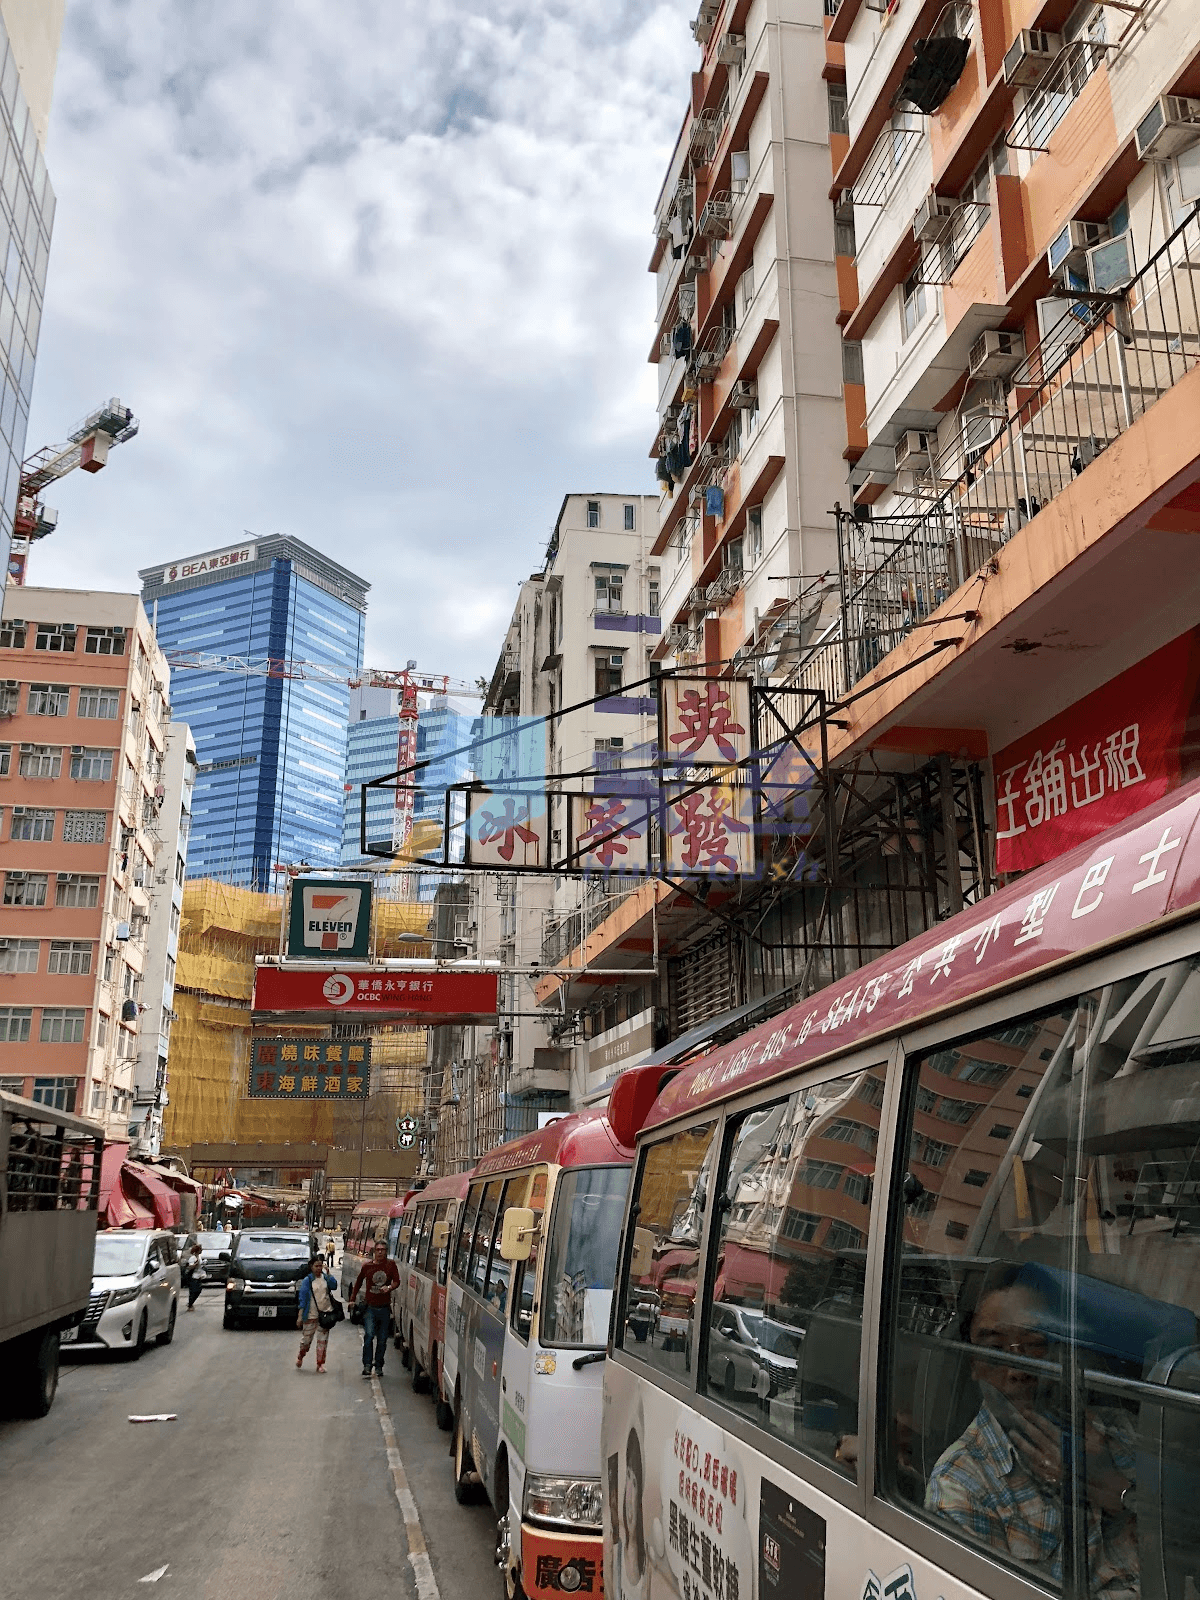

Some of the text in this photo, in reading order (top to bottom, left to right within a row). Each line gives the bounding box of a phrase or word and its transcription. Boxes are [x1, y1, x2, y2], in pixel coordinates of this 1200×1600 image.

[182, 550, 250, 577] BEA 東亞銀行
[898, 827, 1181, 999] 公共小型巴士
[357, 993, 380, 1001] OCBC
[382, 993, 405, 1001] WING
[358, 980, 433, 992] 華僑永亨銀行
[687, 972, 893, 1098] PUBLIC LIGHT BUS 16 SEATS
[281, 1044, 364, 1061] 燒味餐廳
[256, 1044, 278, 1092] 廣東
[278, 1075, 363, 1093] 海鮮酒家
[535, 1555, 604, 1593] 廣告
